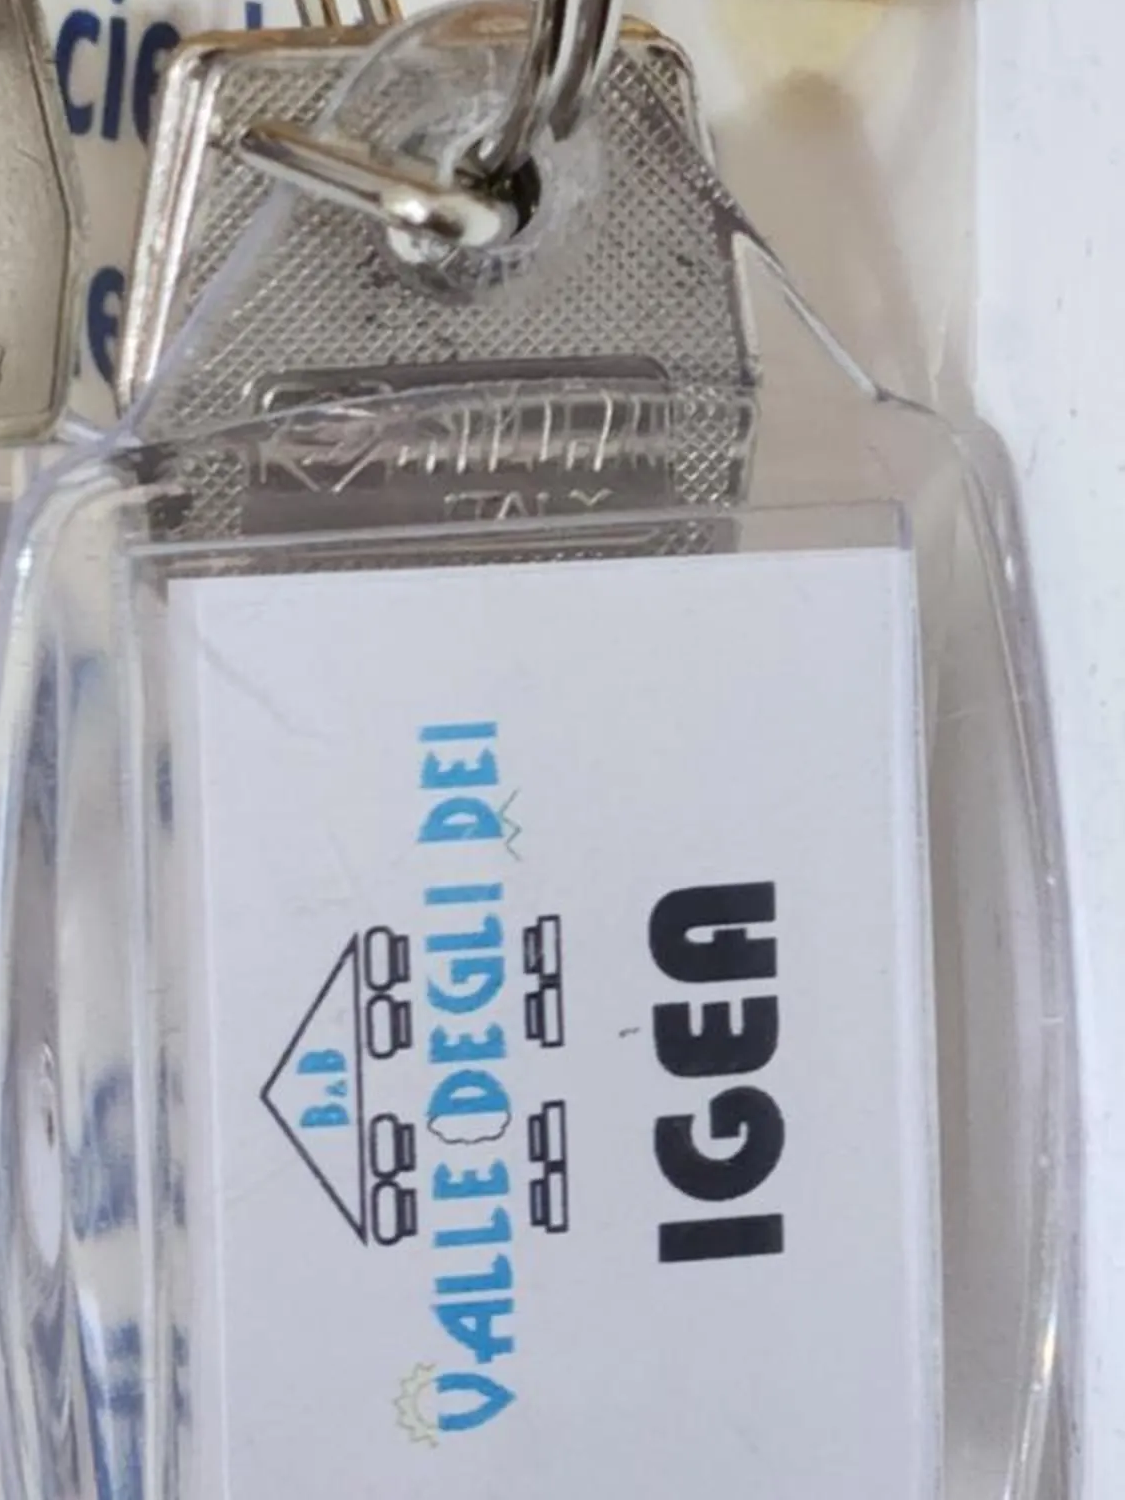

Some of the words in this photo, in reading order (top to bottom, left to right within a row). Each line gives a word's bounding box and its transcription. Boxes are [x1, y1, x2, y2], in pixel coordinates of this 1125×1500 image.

[417, 721, 505, 845] DEI
[424, 881, 511, 1119] DEGLI
[648, 880, 786, 1264] IGEA
[431, 1157, 517, 1432] VALLE
